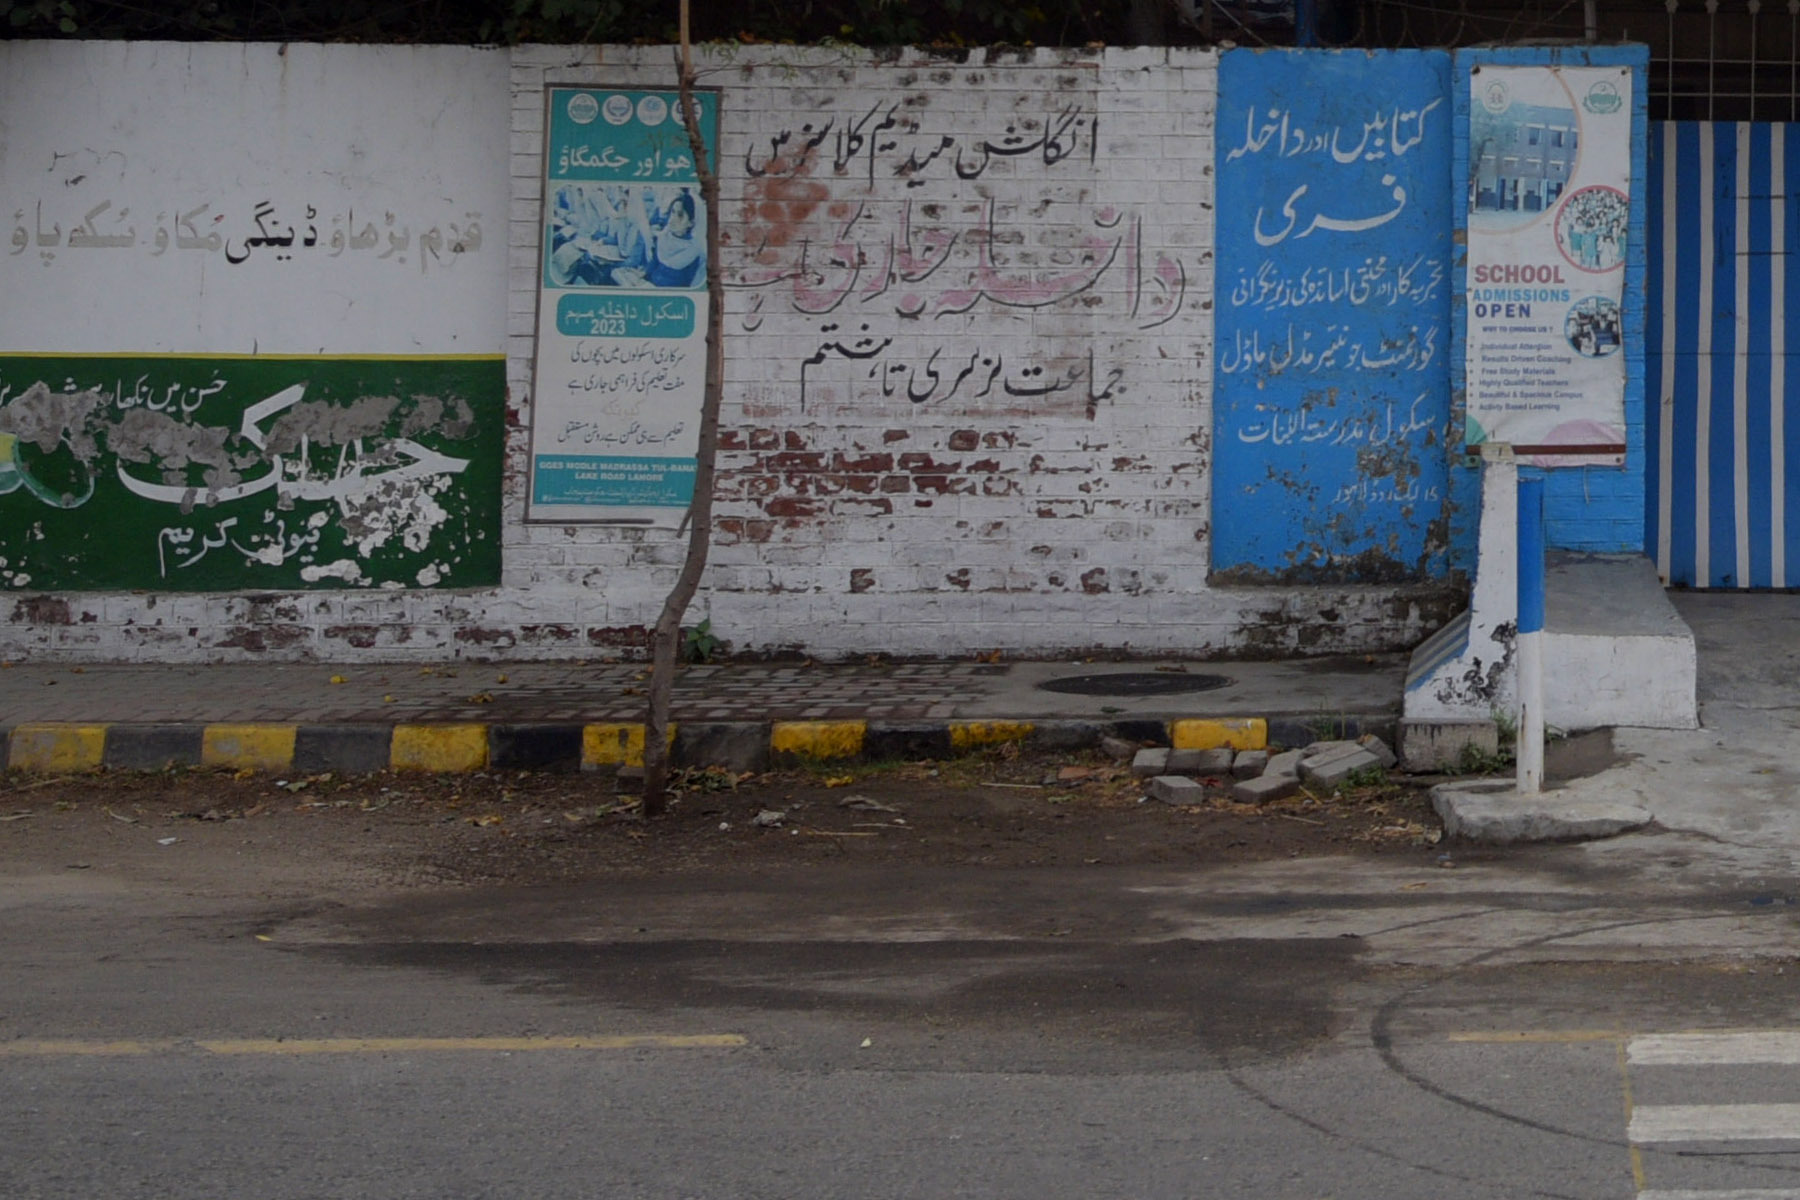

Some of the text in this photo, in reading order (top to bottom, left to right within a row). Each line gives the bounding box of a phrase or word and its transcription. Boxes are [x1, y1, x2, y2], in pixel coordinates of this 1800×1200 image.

[1226, 107, 1305, 163] داخلہ
[1331, 98, 1443, 163] کتابیں
[1253, 174, 1407, 247] فری
[225, 200, 318, 265] ڈینگی
[1474, 264, 1565, 285] SCHOOL
[1473, 288, 1571, 302] ADMISSIONS
[599, 301, 639, 321] داخلہ
[639, 301, 689, 327] اسکول
[1475, 303, 1531, 318] OPEN
[591, 319, 627, 336] 2023
